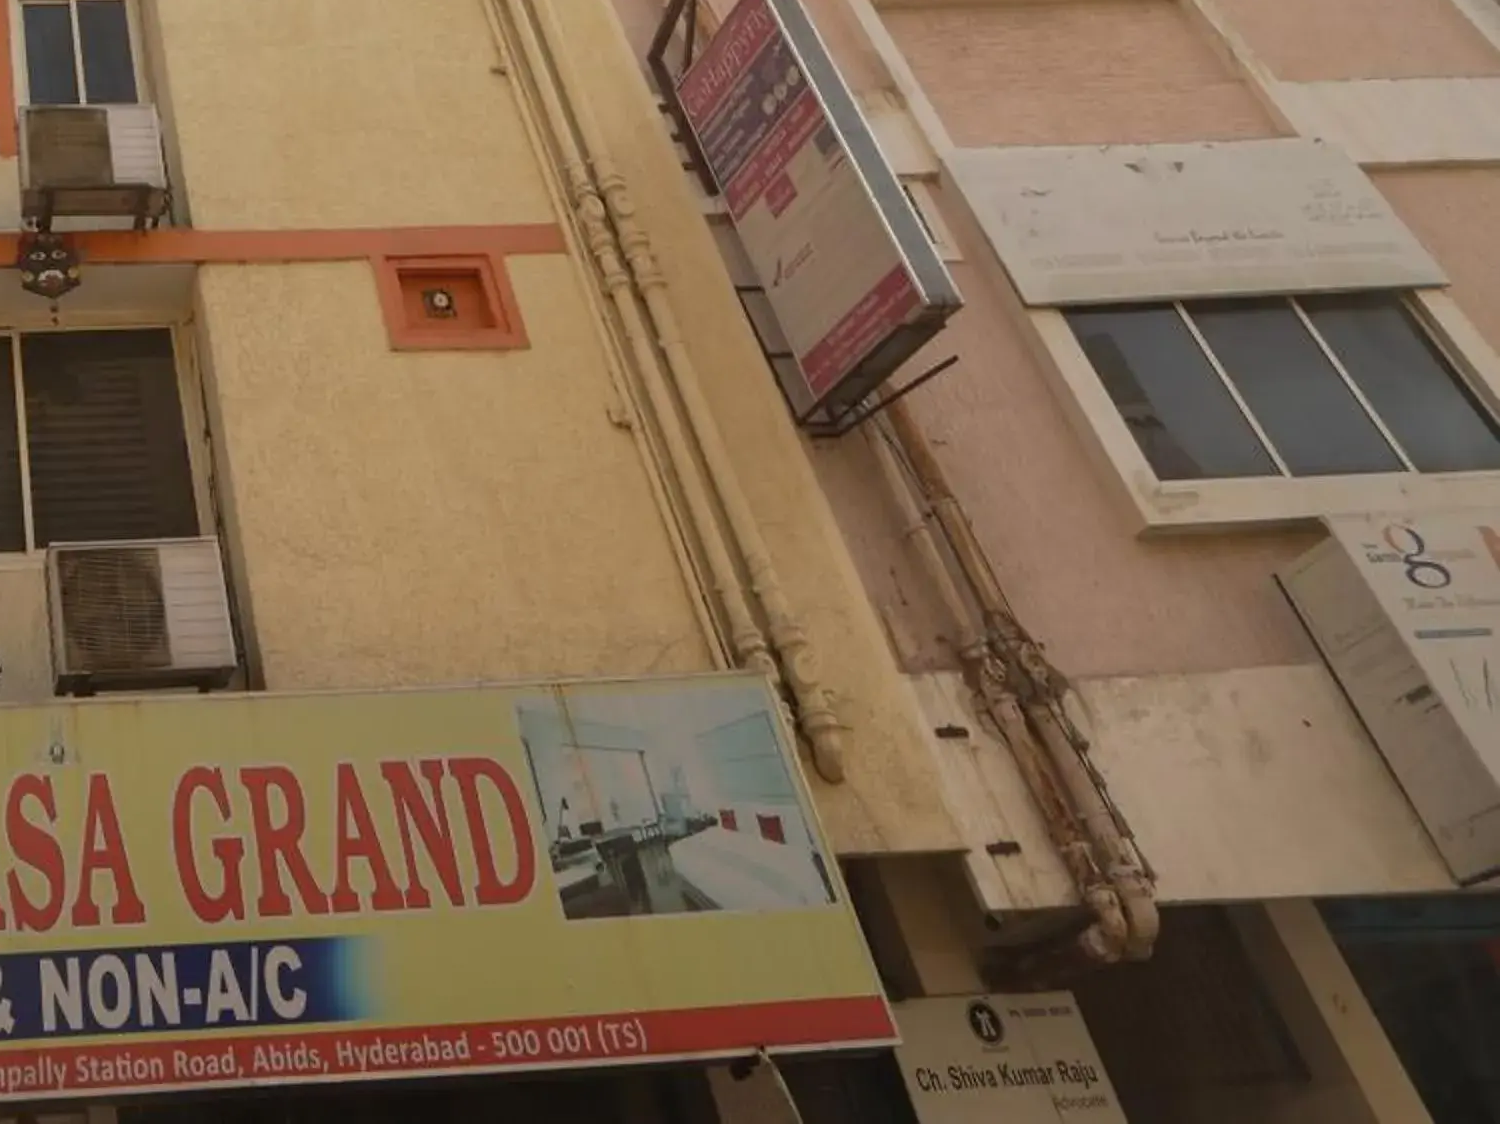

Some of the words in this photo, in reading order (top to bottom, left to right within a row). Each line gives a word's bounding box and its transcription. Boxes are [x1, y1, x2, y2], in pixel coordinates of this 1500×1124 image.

[171, 756, 537, 924] GRAND
[39, 944, 308, 1032] NON-A/C
[75, 1050, 165, 1082] Station
[174, 1046, 244, 1078] Road,
[252, 1040, 330, 1074] Abids,
[337, 1031, 469, 1067] Hyderabad
[491, 1032, 539, 1058] 500
[546, 1028, 592, 1054] 001
[598, 1019, 647, 1054] (TS)
[915, 1067, 947, 1093] Ch.
[947, 1063, 998, 1091] Shiva
[998, 1061, 1054, 1087] Kumar
[1054, 1059, 1100, 1089] Raju
